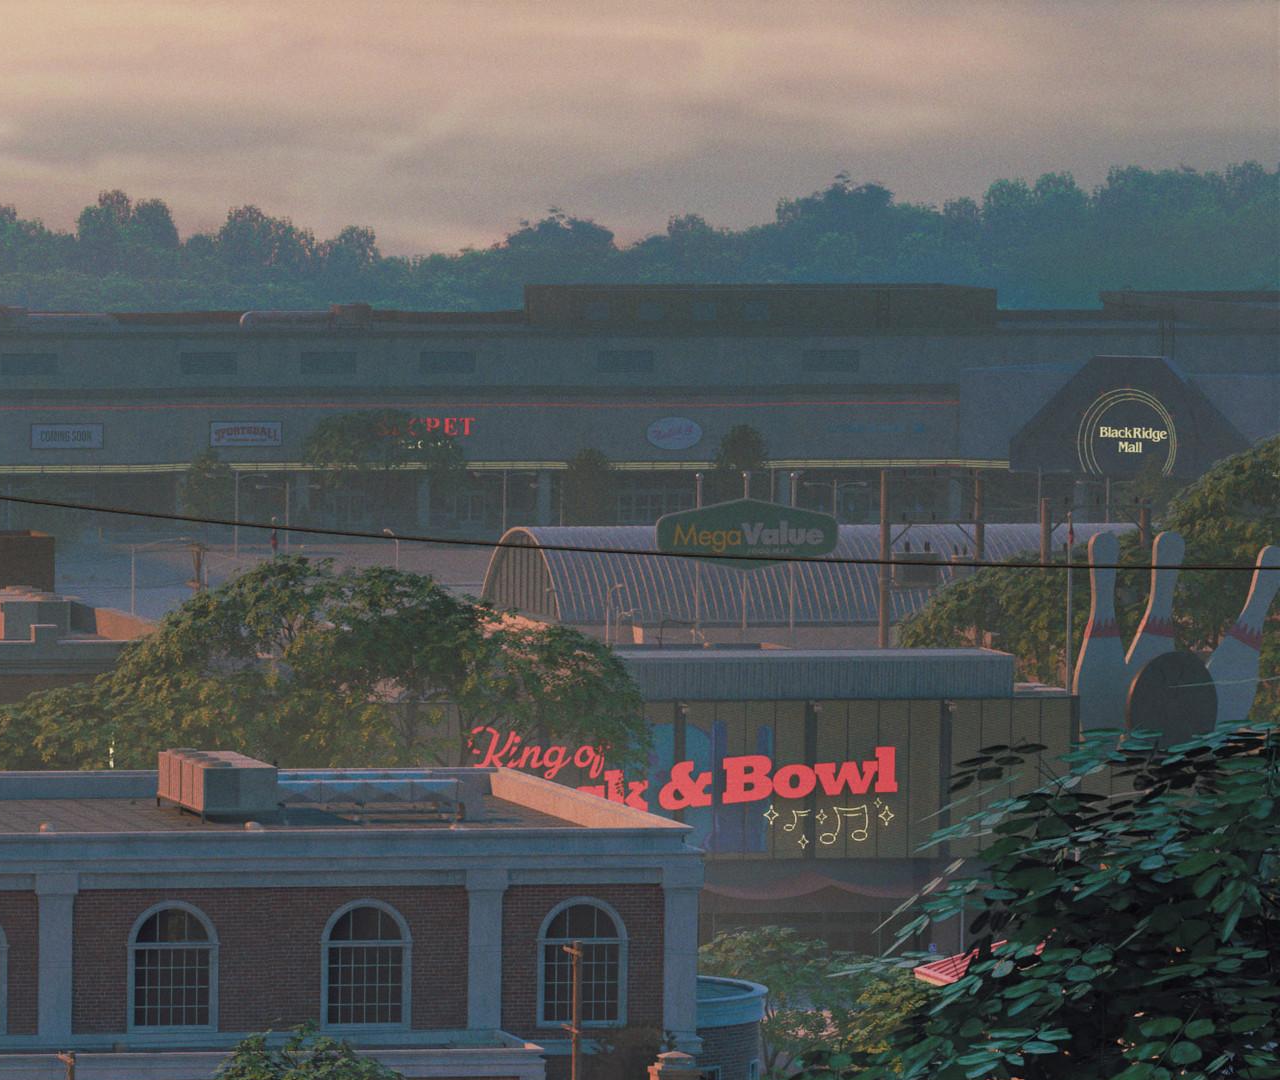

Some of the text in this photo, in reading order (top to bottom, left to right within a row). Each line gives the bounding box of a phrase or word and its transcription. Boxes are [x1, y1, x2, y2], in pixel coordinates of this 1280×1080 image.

[40, 430, 93, 442] COMING SOON
[1118, 441, 1143, 453] Mall
[467, 725, 572, 780] King
[722, 746, 898, 804] Bowl
